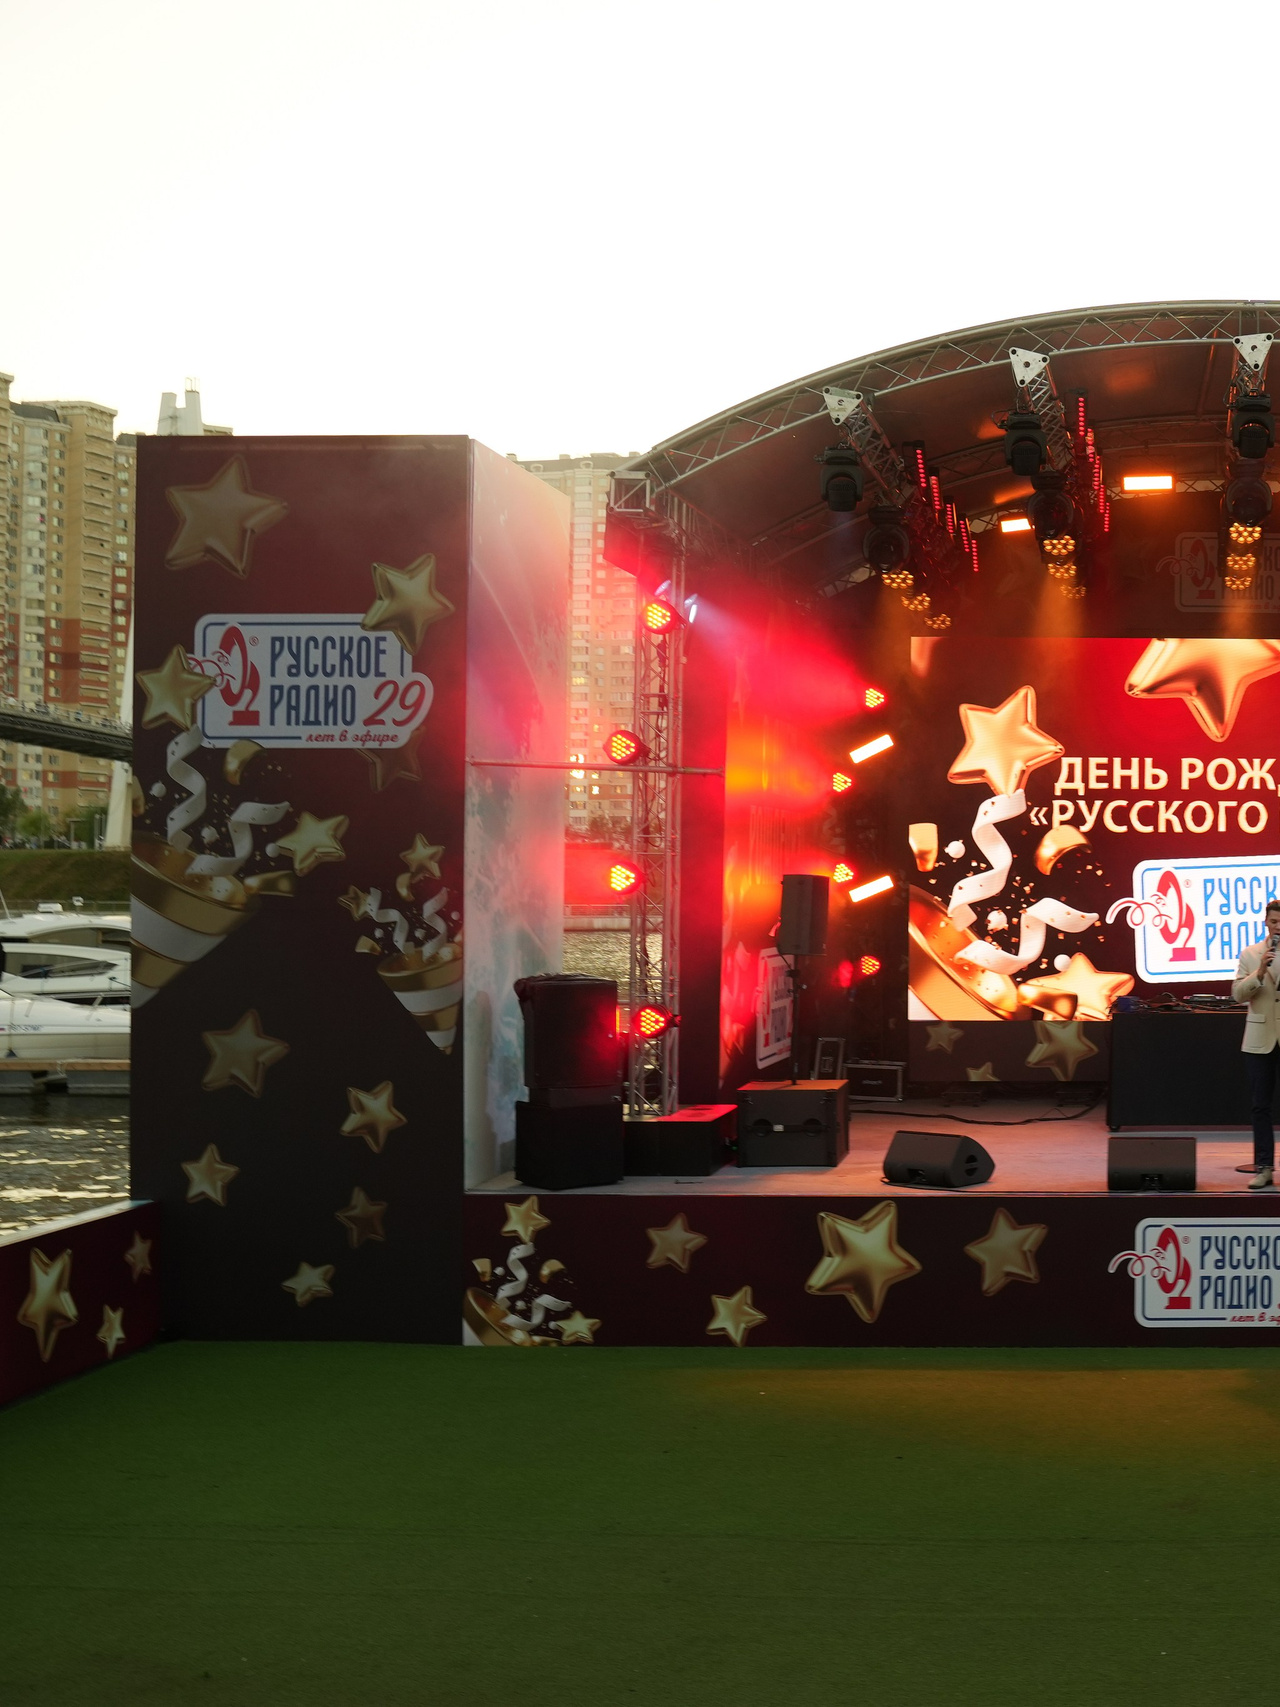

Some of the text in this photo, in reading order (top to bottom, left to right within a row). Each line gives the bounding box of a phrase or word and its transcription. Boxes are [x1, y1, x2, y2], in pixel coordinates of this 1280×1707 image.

[269, 635, 388, 679] РУССКОЕ
[268, 679, 427, 728] РАДИО 29
[305, 729, 400, 747] лет в эфире
[1053, 756, 1169, 796] ДЕНЬ
[1028, 799, 1270, 835] «РУССКОГО
[1204, 920, 1267, 961] РАДИ
[1199, 1275, 1273, 1310] РАДИО
[1229, 1313, 1256, 1323] лет
